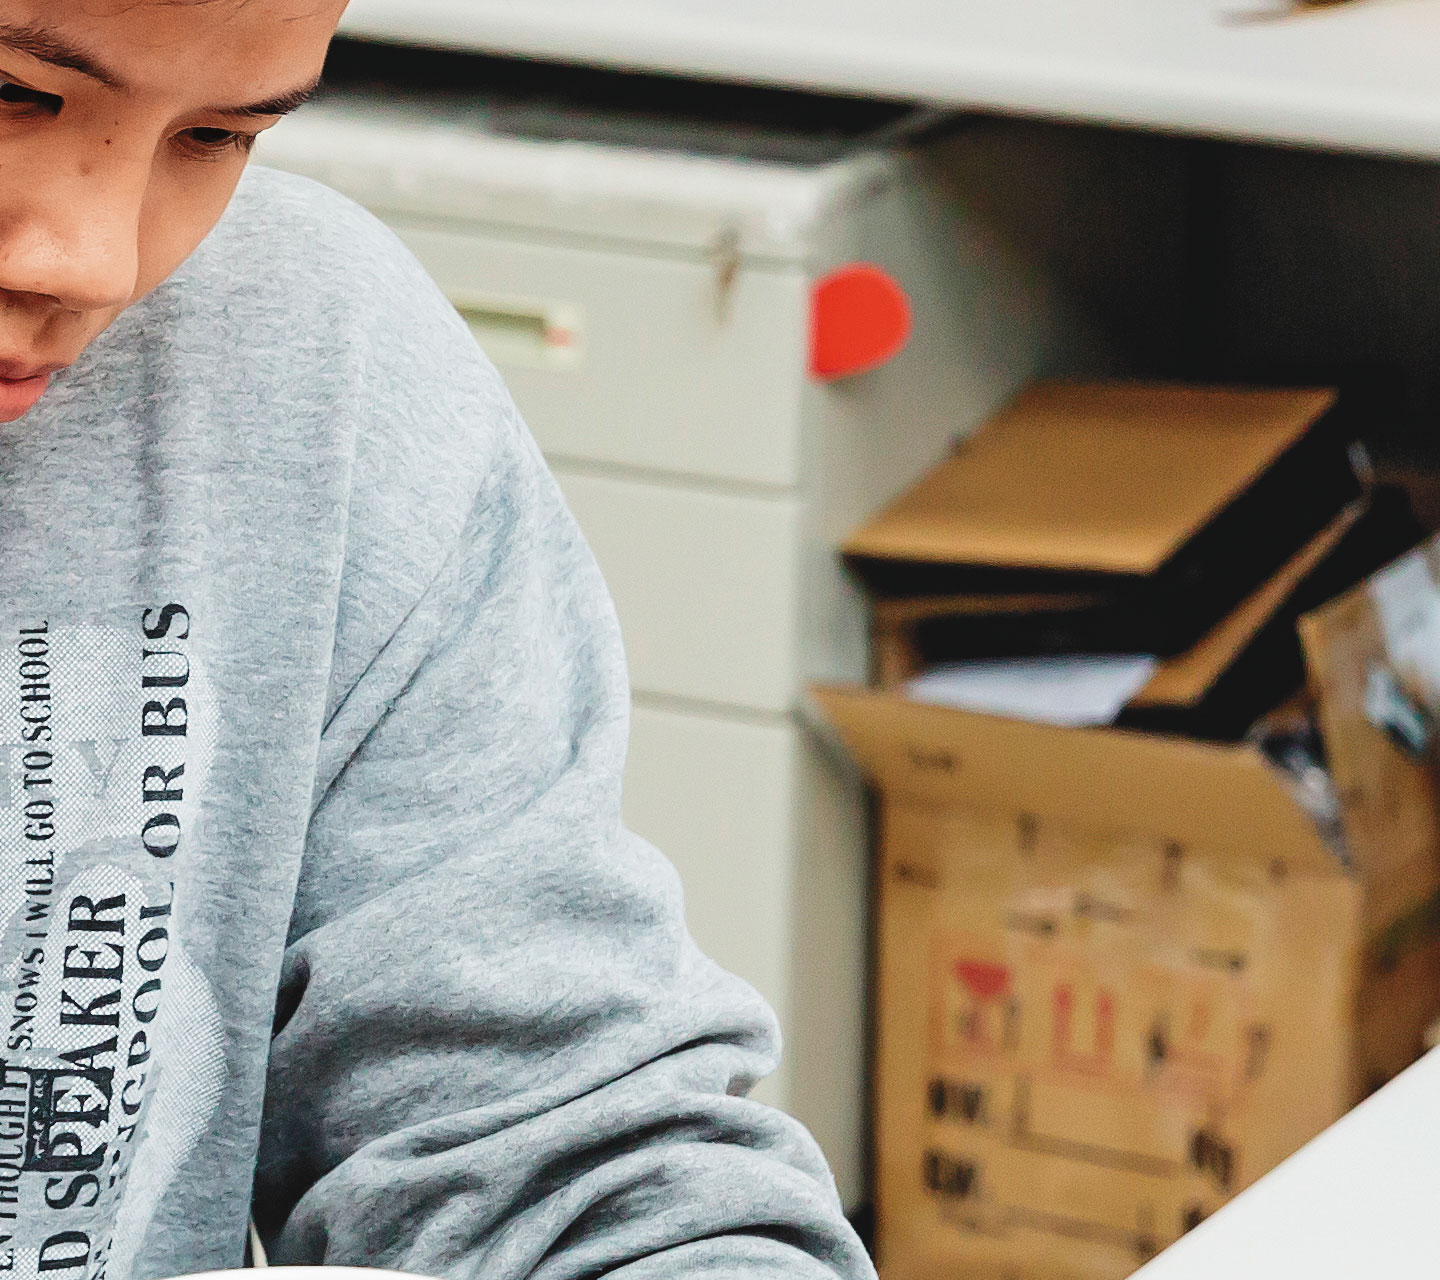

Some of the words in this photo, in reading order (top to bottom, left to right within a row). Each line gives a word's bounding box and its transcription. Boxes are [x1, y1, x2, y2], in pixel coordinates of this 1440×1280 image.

[18, 620, 53, 742] SCHOOL
[141, 603, 190, 737] BUS
[22, 750, 54, 789] TO
[23, 799, 56, 841] GO
[141, 761, 185, 858] OR
[24, 851, 56, 923] WILL
[7, 947, 46, 1052] SNOWS
[44, 893, 126, 1209] SPEAKER
